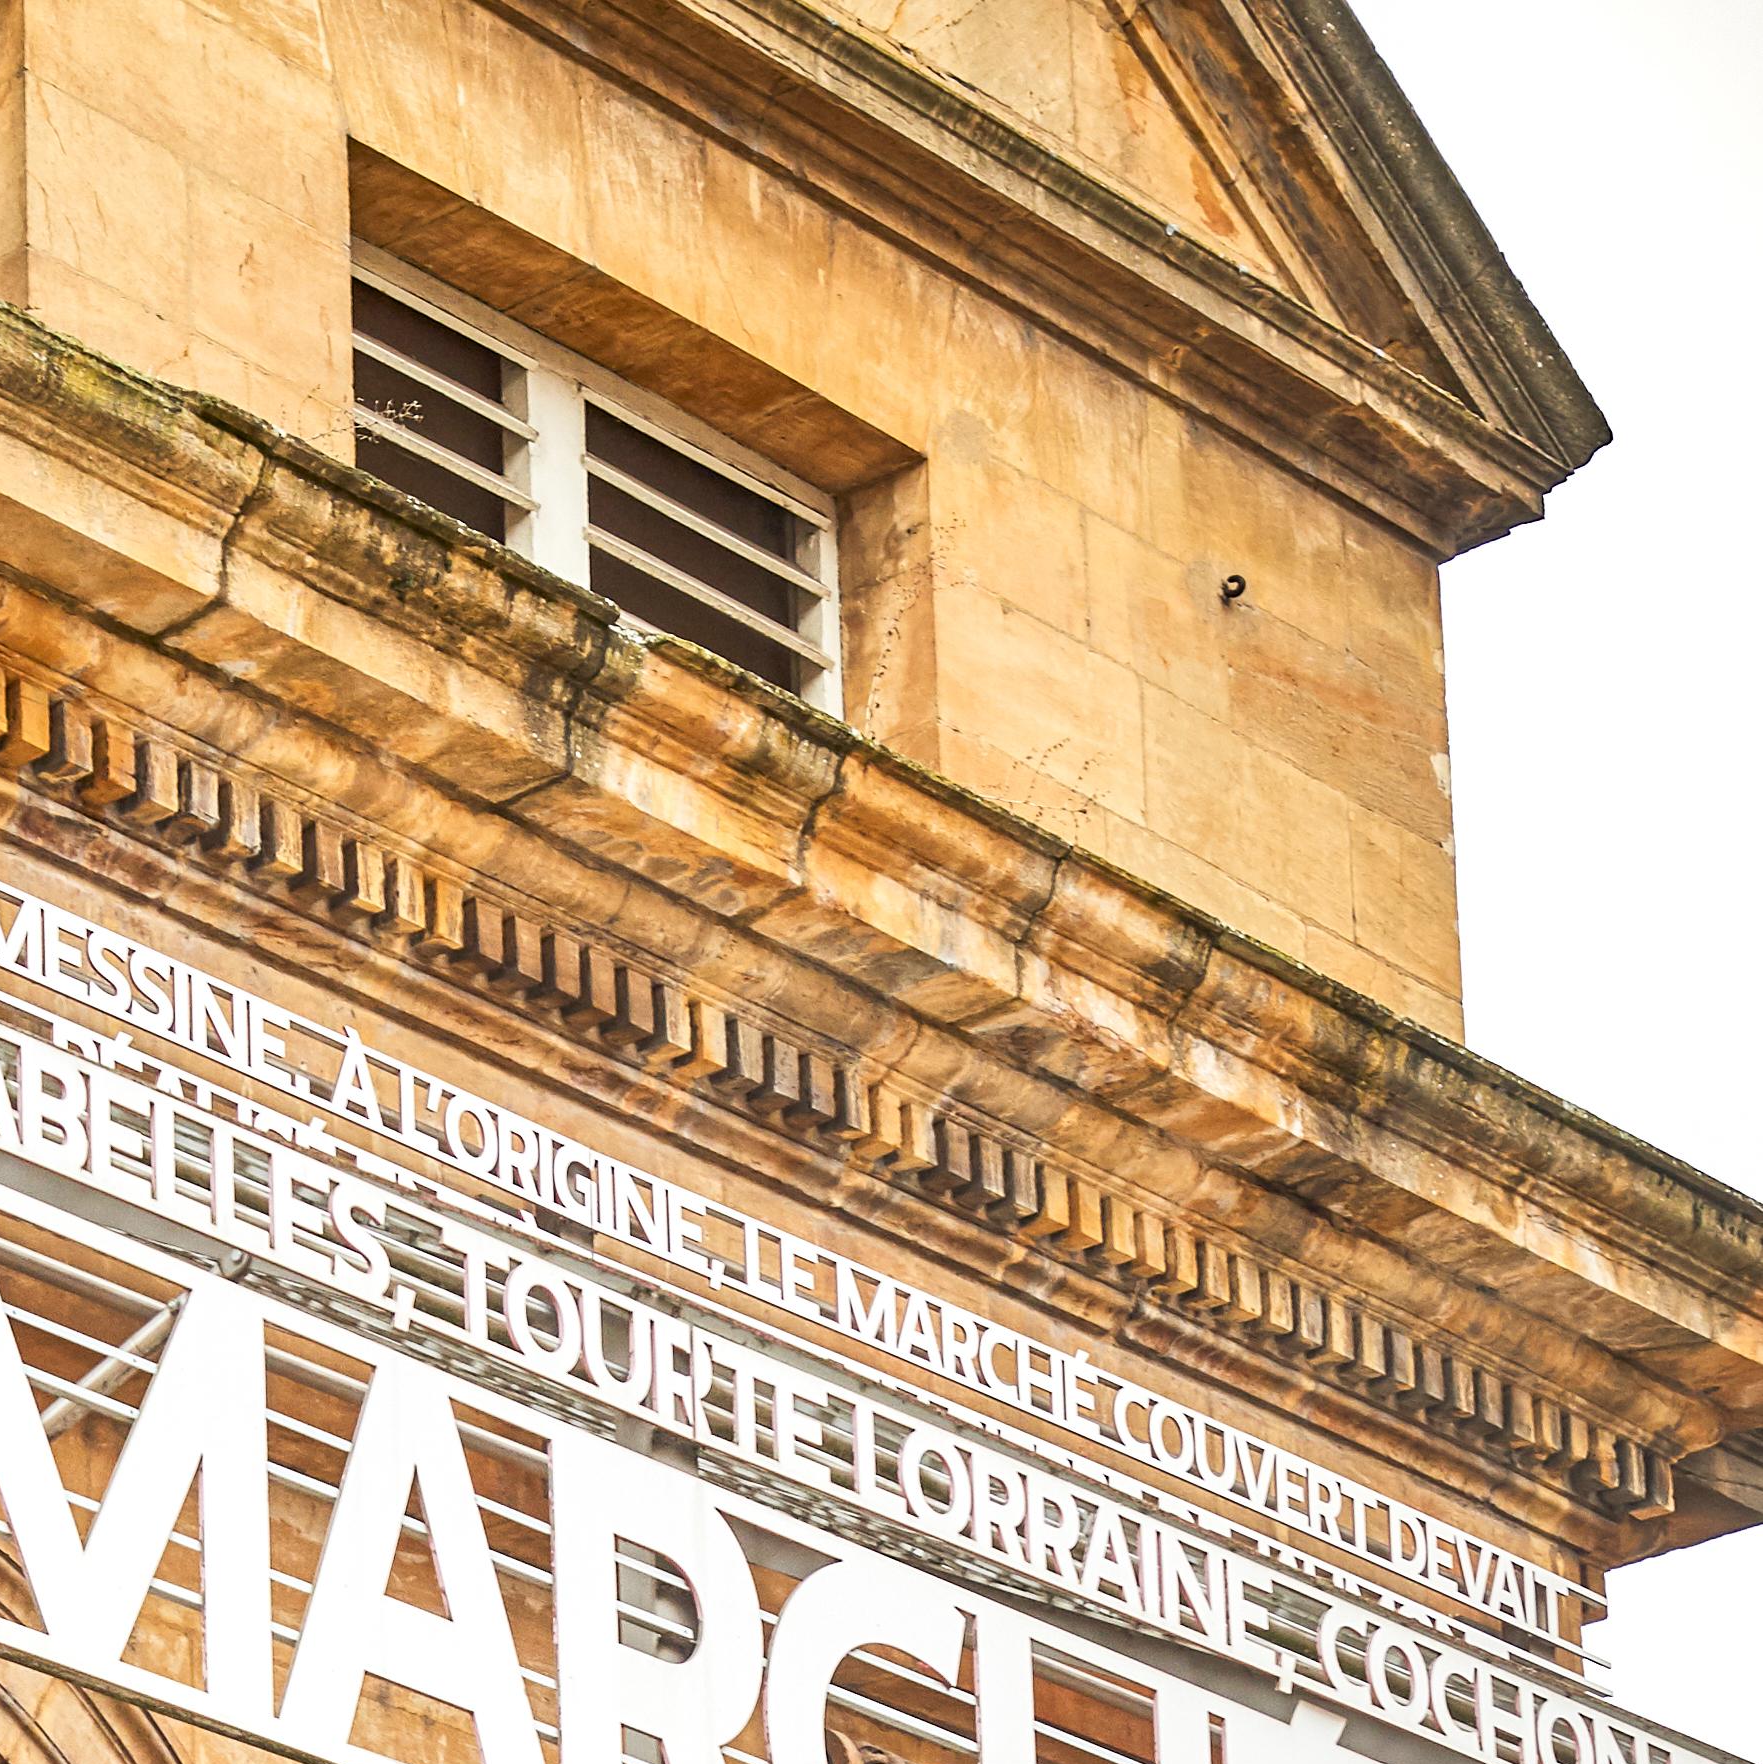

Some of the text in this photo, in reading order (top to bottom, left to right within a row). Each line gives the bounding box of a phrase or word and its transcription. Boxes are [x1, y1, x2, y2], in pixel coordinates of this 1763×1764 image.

[443, 1211, 832, 1492] TOURTE
[854, 1389, 1299, 1693] LORRAINE,
[745, 1218, 820, 1320] LE
[837, 1259, 1100, 1443] MARCHÉ
[1115, 1378, 1376, 1562] COUVERT
[1389, 1498, 1567, 1638] DEVAIT
